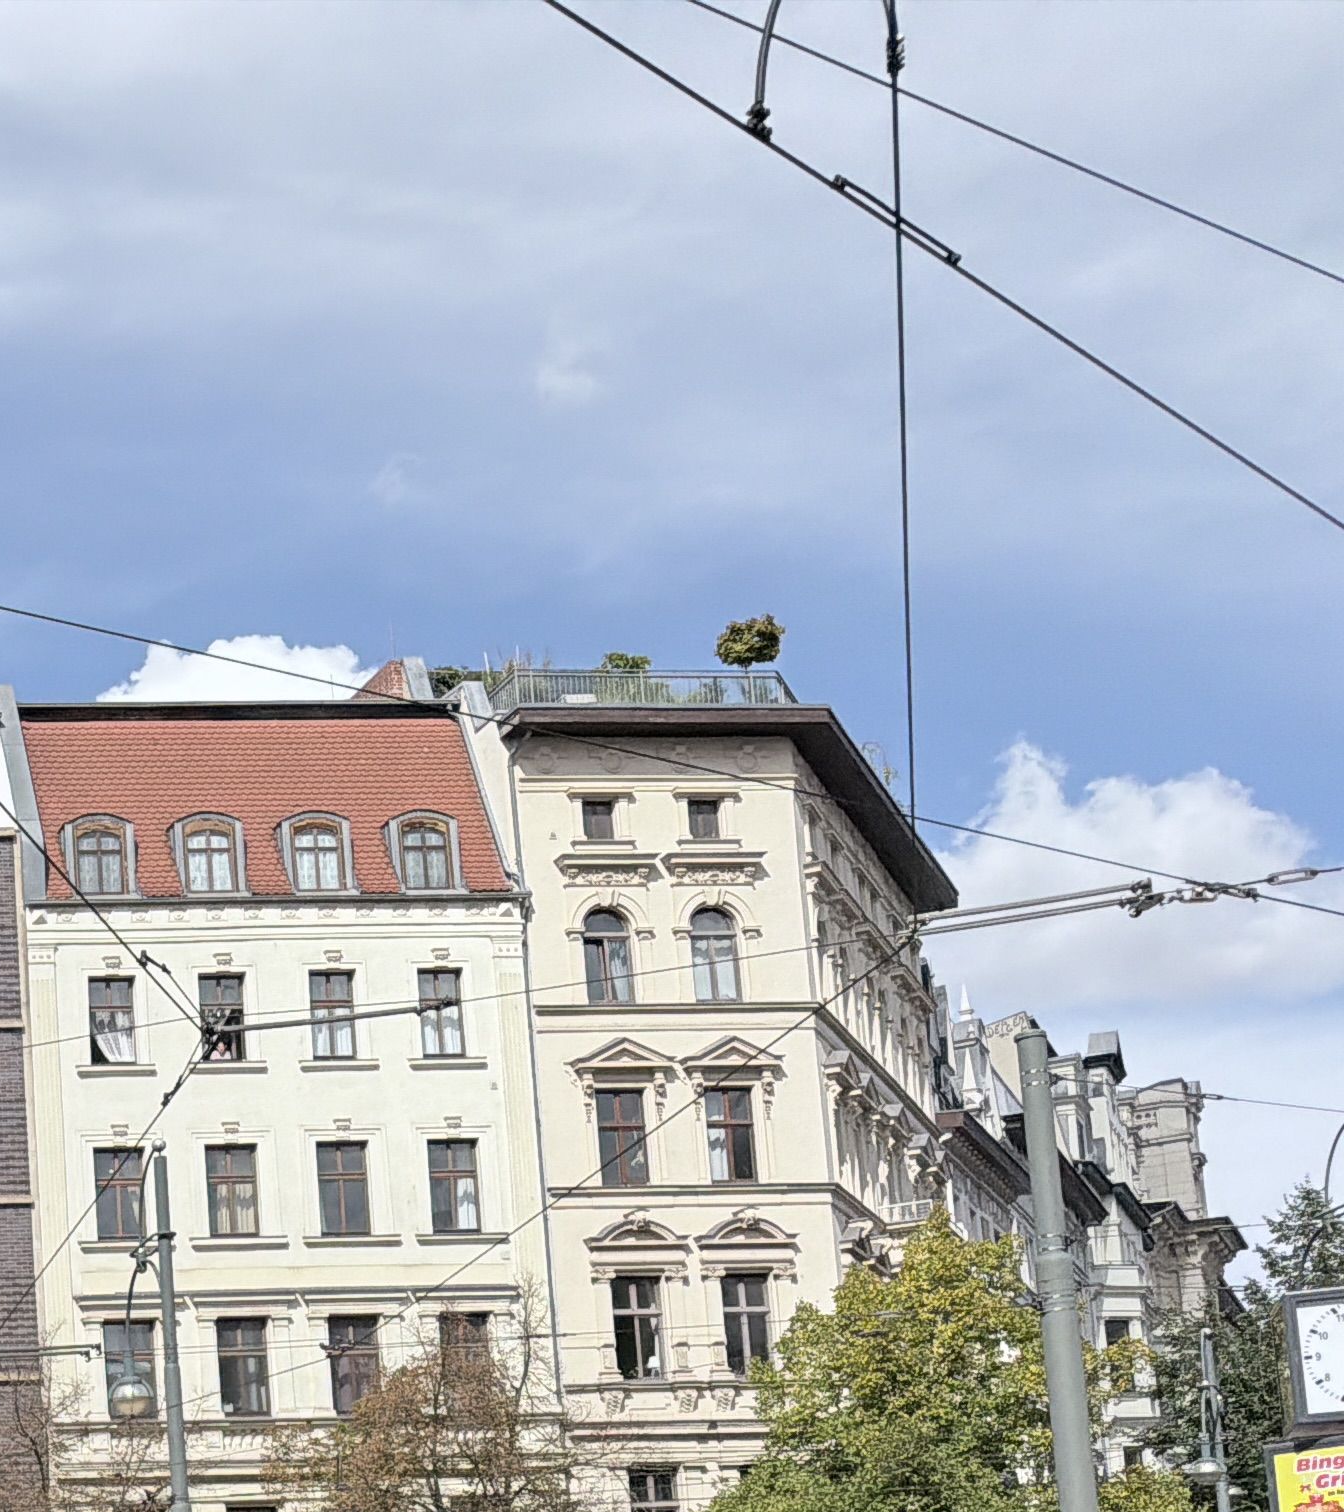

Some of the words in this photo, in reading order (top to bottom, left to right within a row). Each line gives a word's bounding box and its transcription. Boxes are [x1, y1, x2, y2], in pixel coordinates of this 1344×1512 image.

[1318, 1332, 1328, 1340] 10
[1315, 1352, 1321, 1361] 9
[1324, 1373, 1330, 1382] 8
